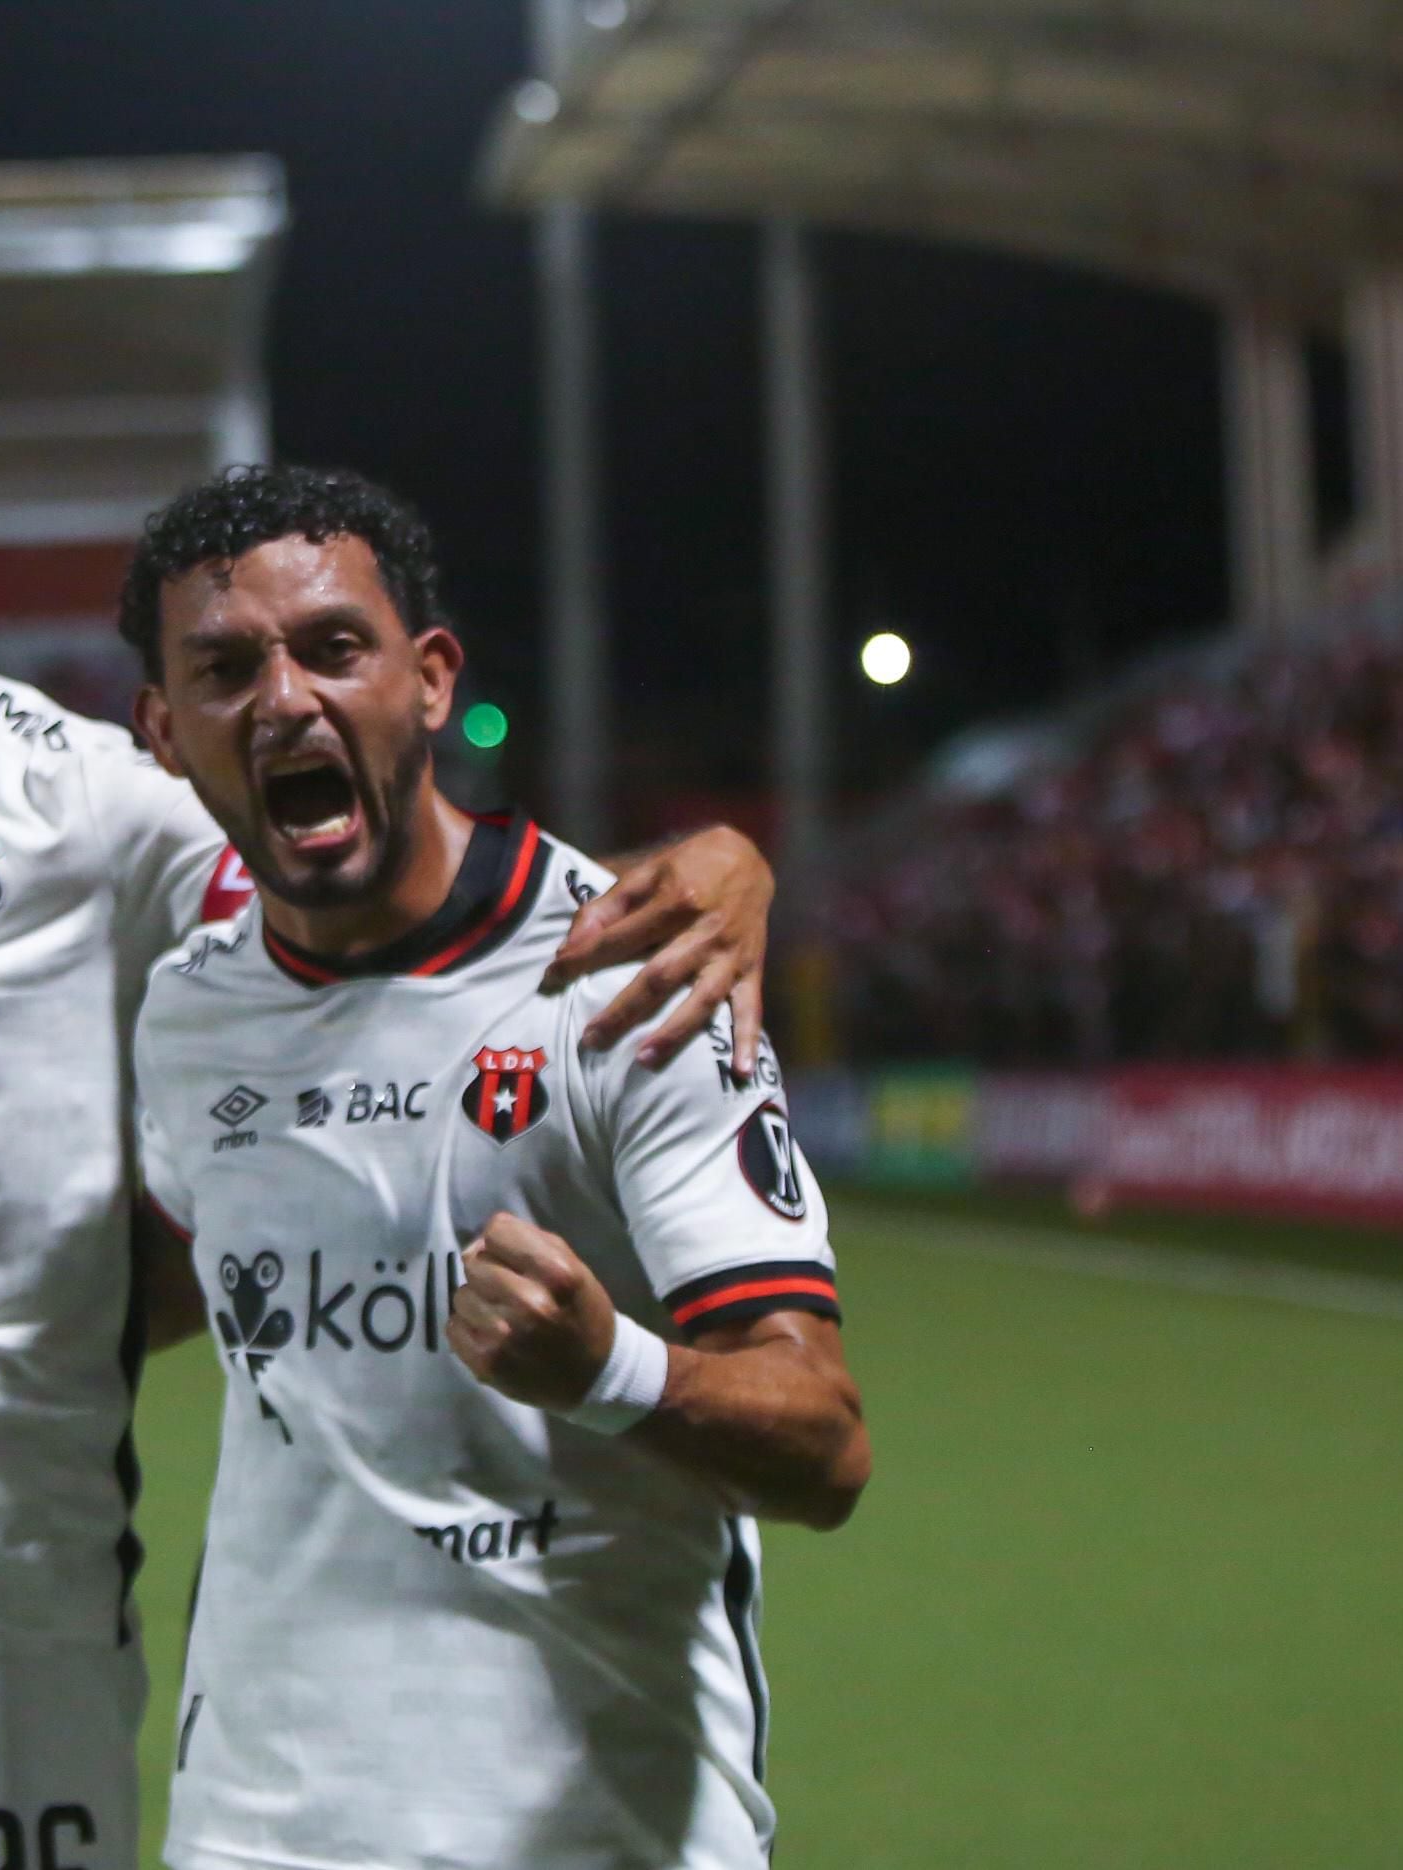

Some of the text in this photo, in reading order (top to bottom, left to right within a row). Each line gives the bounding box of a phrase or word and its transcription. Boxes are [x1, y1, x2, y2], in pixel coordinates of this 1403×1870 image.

[484, 1053, 535, 1070] LDA
[346, 1081, 431, 1125] BAC
[213, 1130, 259, 1152] umbro
